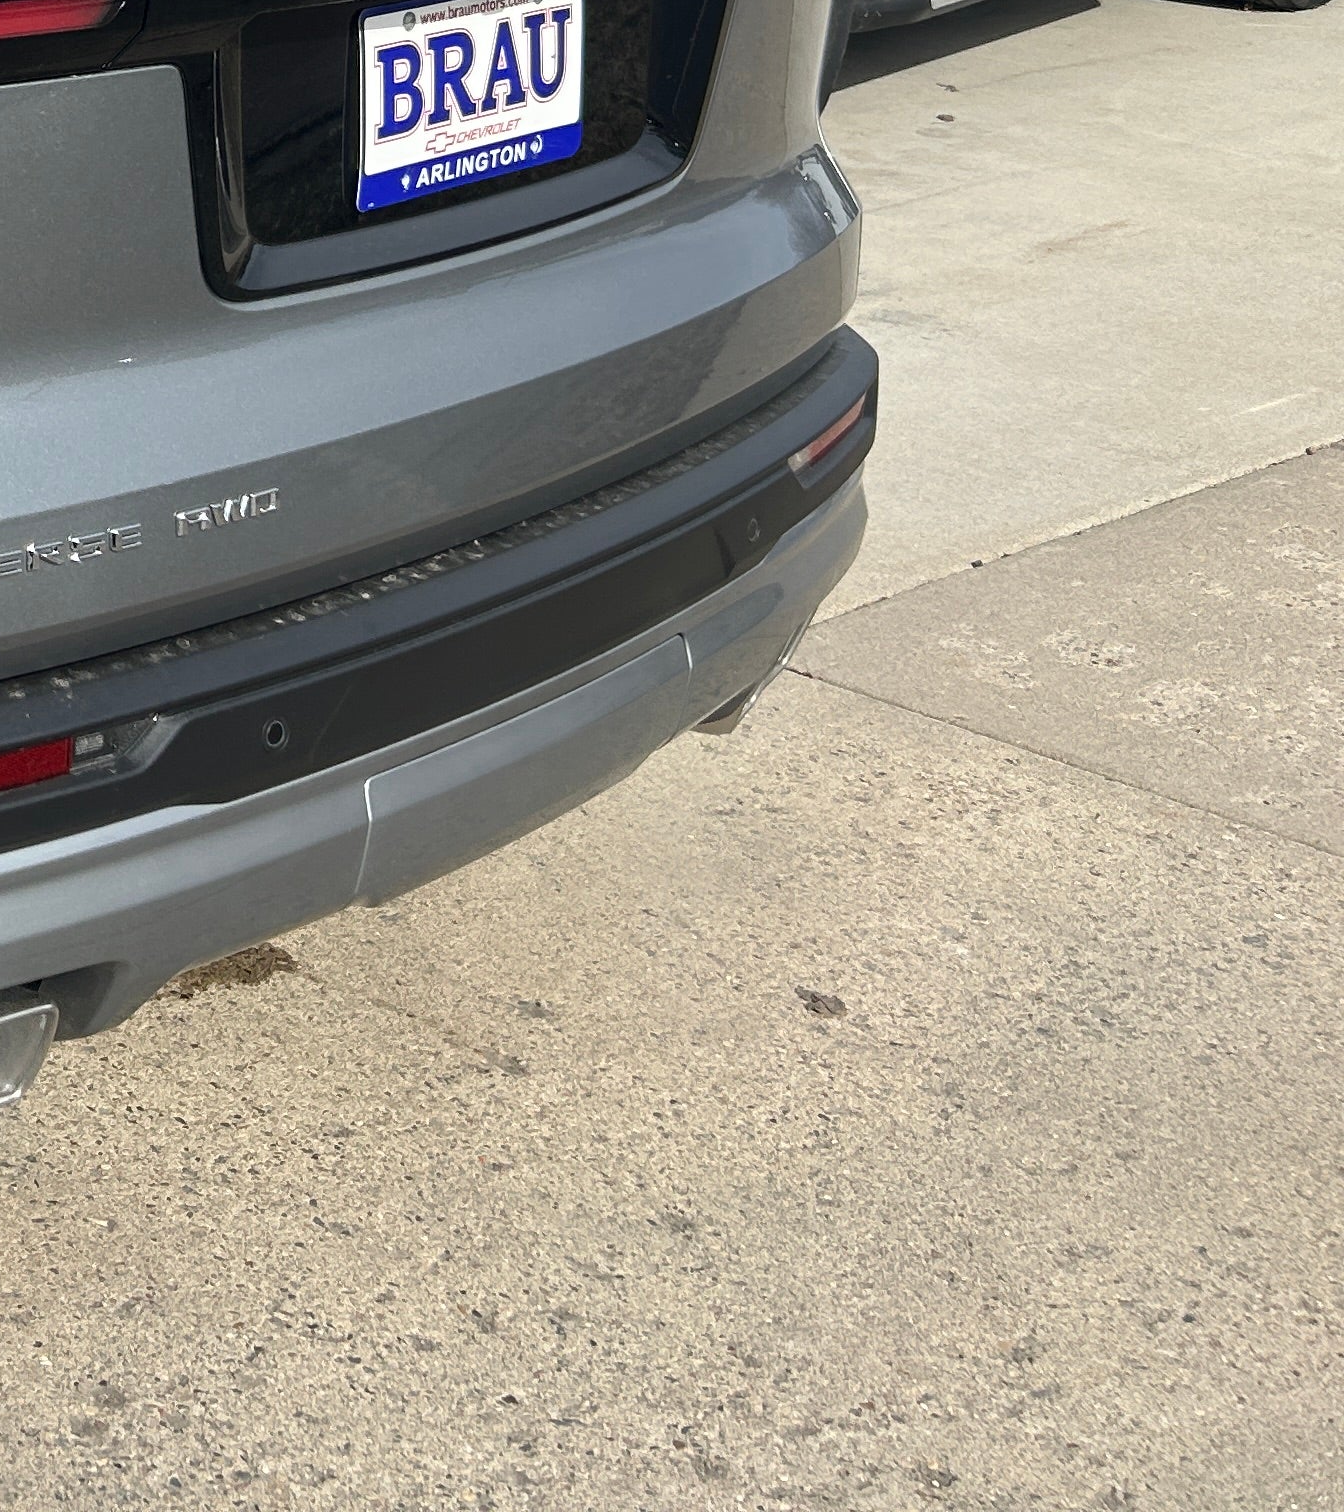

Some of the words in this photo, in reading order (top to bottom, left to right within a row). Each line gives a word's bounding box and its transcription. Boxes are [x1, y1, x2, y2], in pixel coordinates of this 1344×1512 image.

[374, 4, 572, 145] BRAU
[456, 118, 521, 144] CHEVROLET
[415, 142, 526, 188] ARLINGTON
[175, 487, 279, 537] AWD
